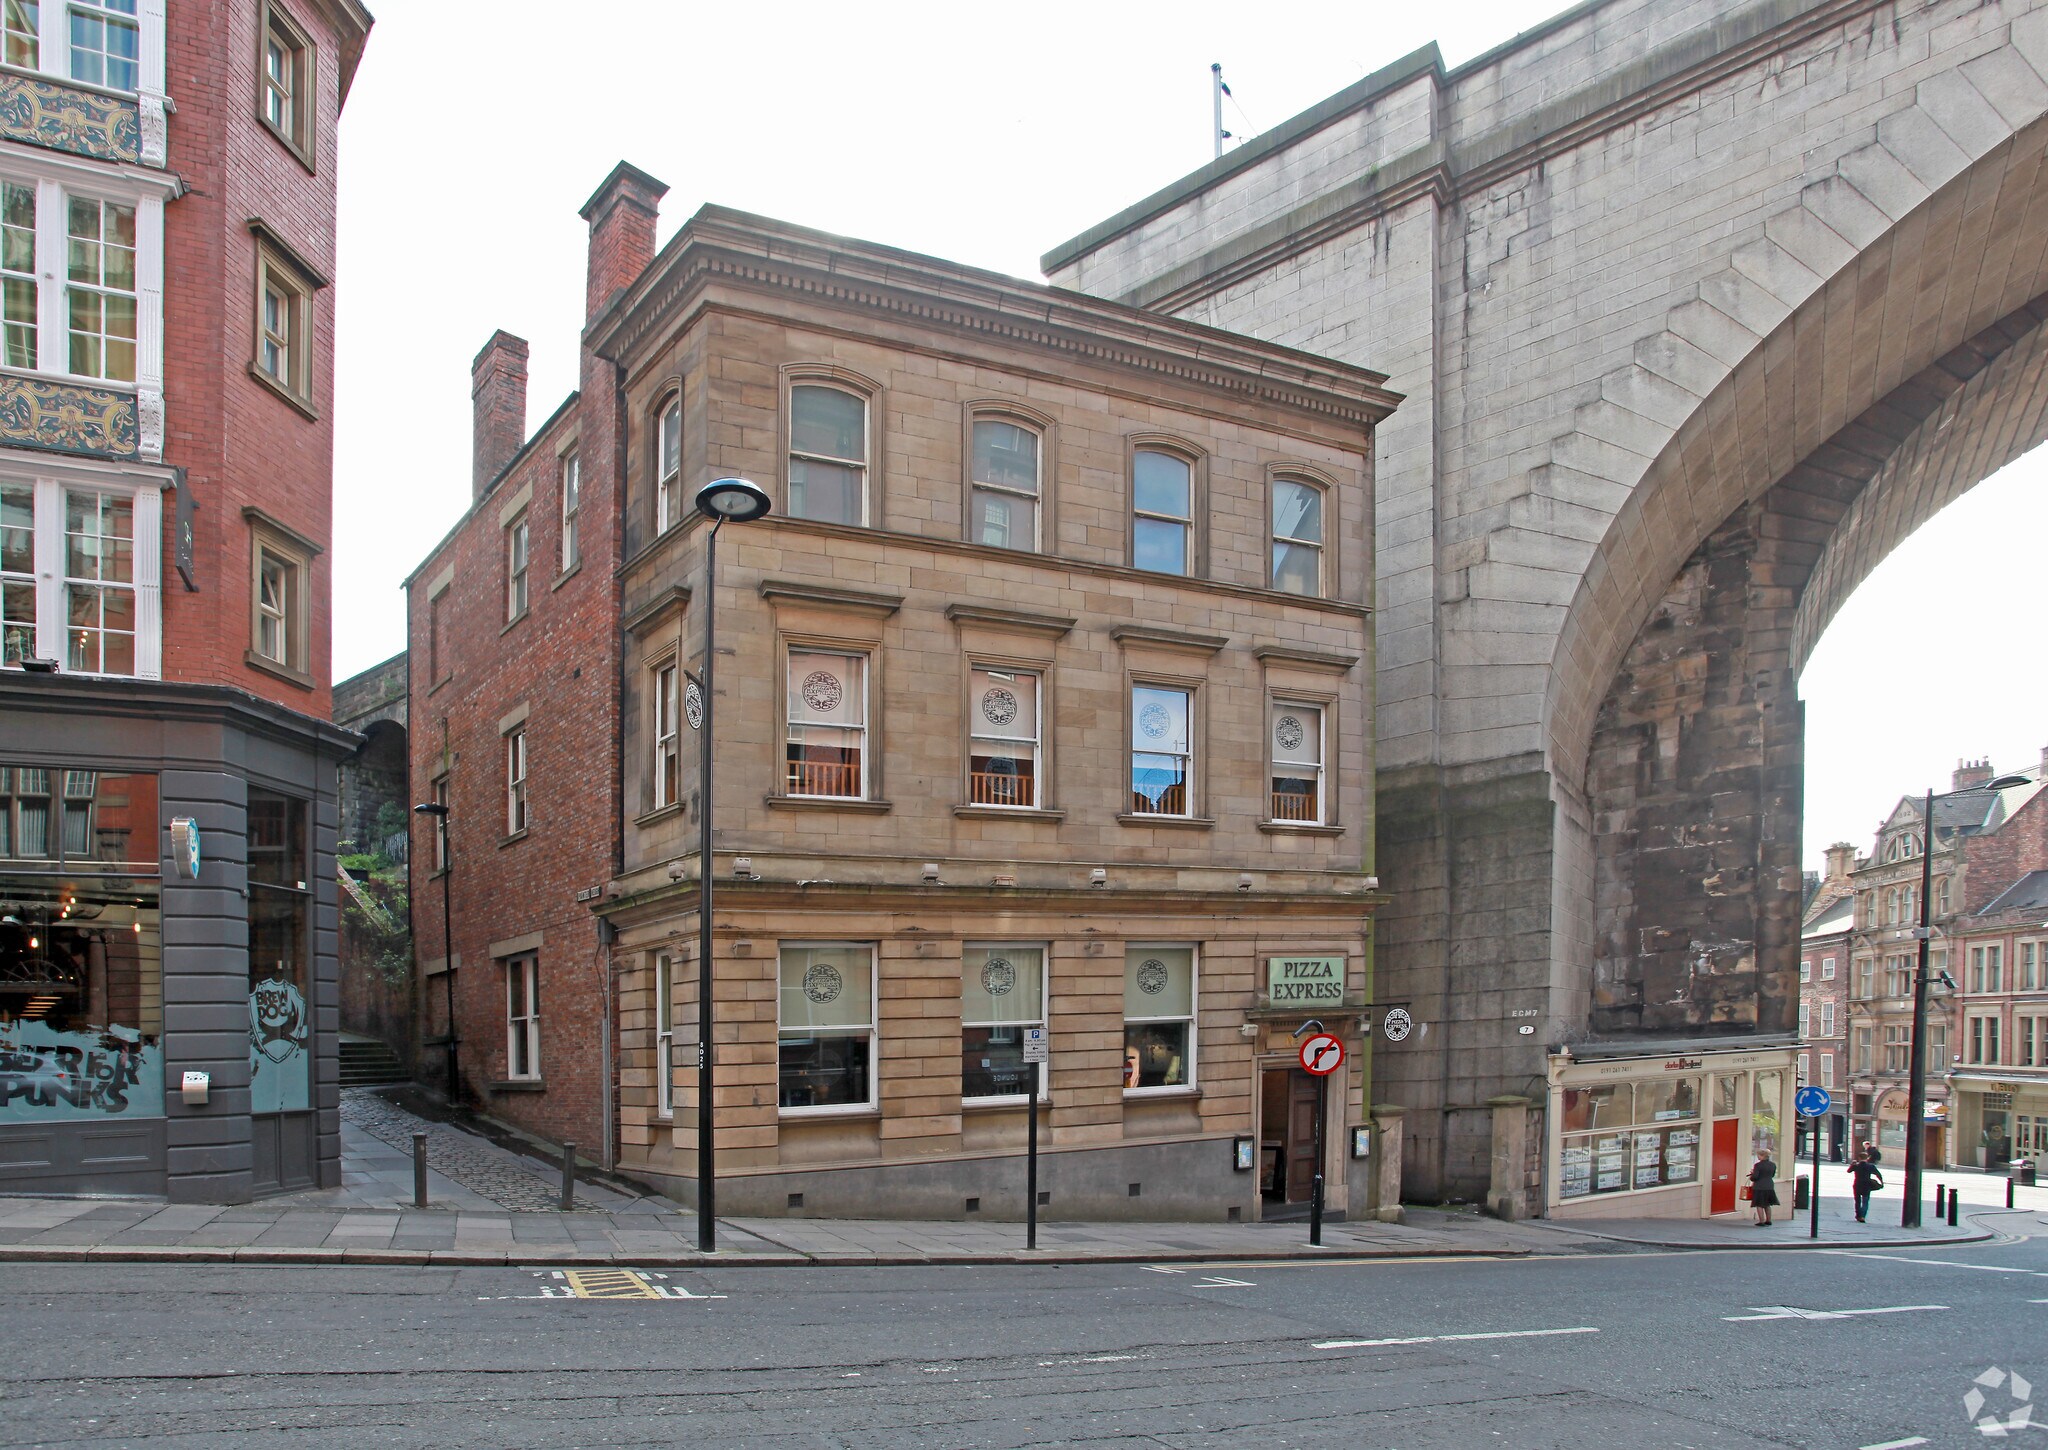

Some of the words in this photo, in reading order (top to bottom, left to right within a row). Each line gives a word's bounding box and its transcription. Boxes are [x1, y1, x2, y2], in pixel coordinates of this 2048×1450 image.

[1284, 962, 1333, 978] PIZZA
[256, 989, 288, 1006] BREW
[1273, 983, 1342, 1000] EXPRESS
[257, 1003, 291, 1019] DOG
[1033, 1030, 1039, 1038] P
[86, 1048, 142, 1085] FOR
[0, 1079, 129, 1113] PUNKS
